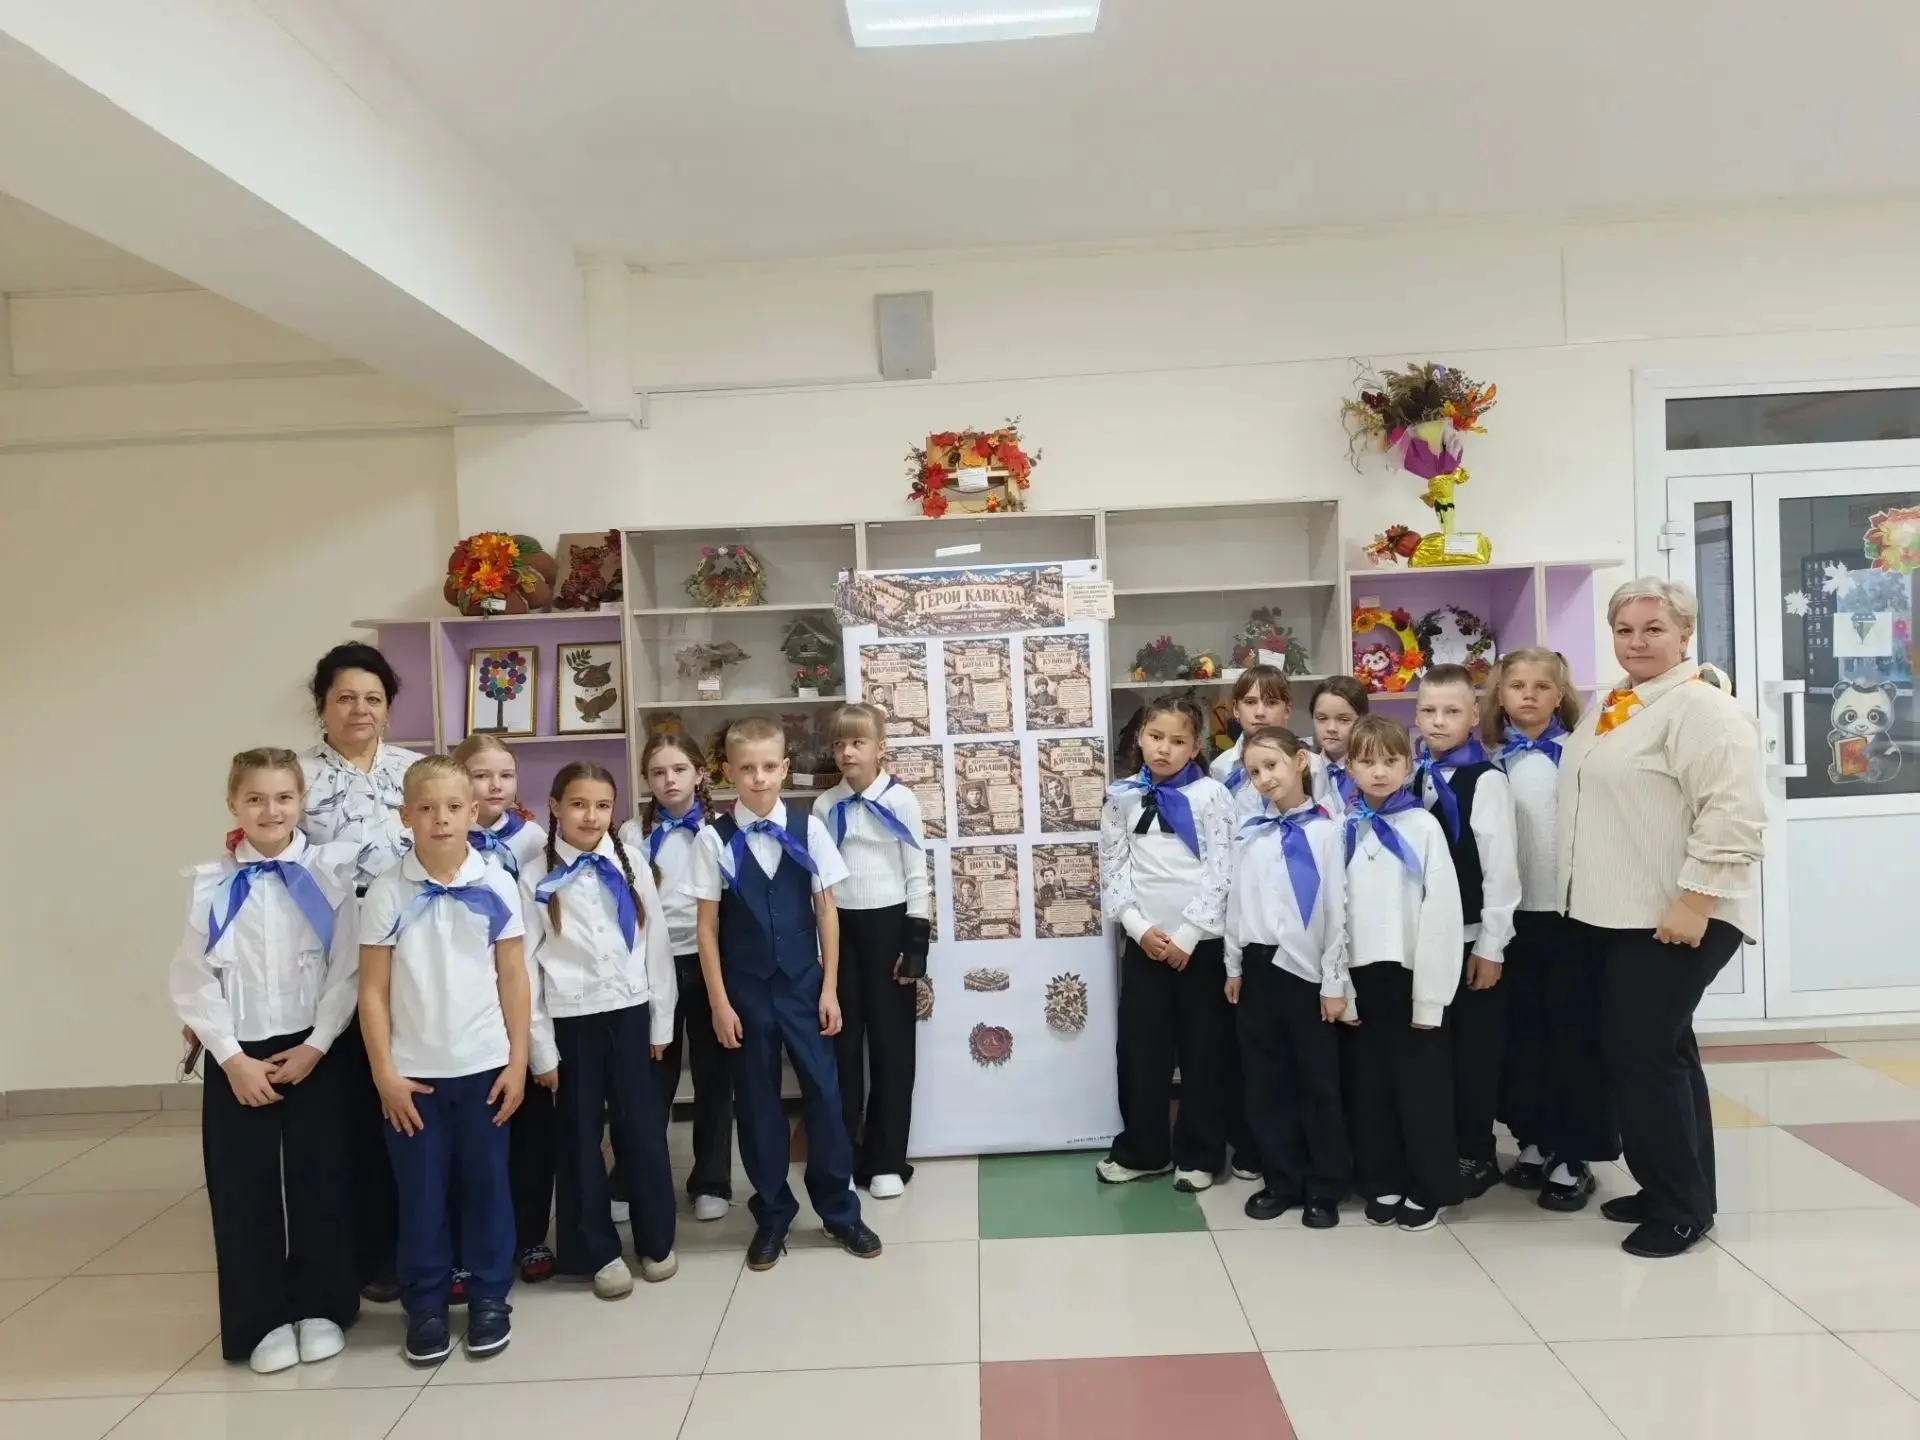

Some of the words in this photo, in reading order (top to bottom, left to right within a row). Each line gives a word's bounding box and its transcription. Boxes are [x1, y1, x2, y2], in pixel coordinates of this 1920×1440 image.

[920, 590, 960, 611] ГЕРОИ
[965, 588, 1022, 606] КАВКАЗА
[968, 763, 1008, 774] БАРБАШОВ
